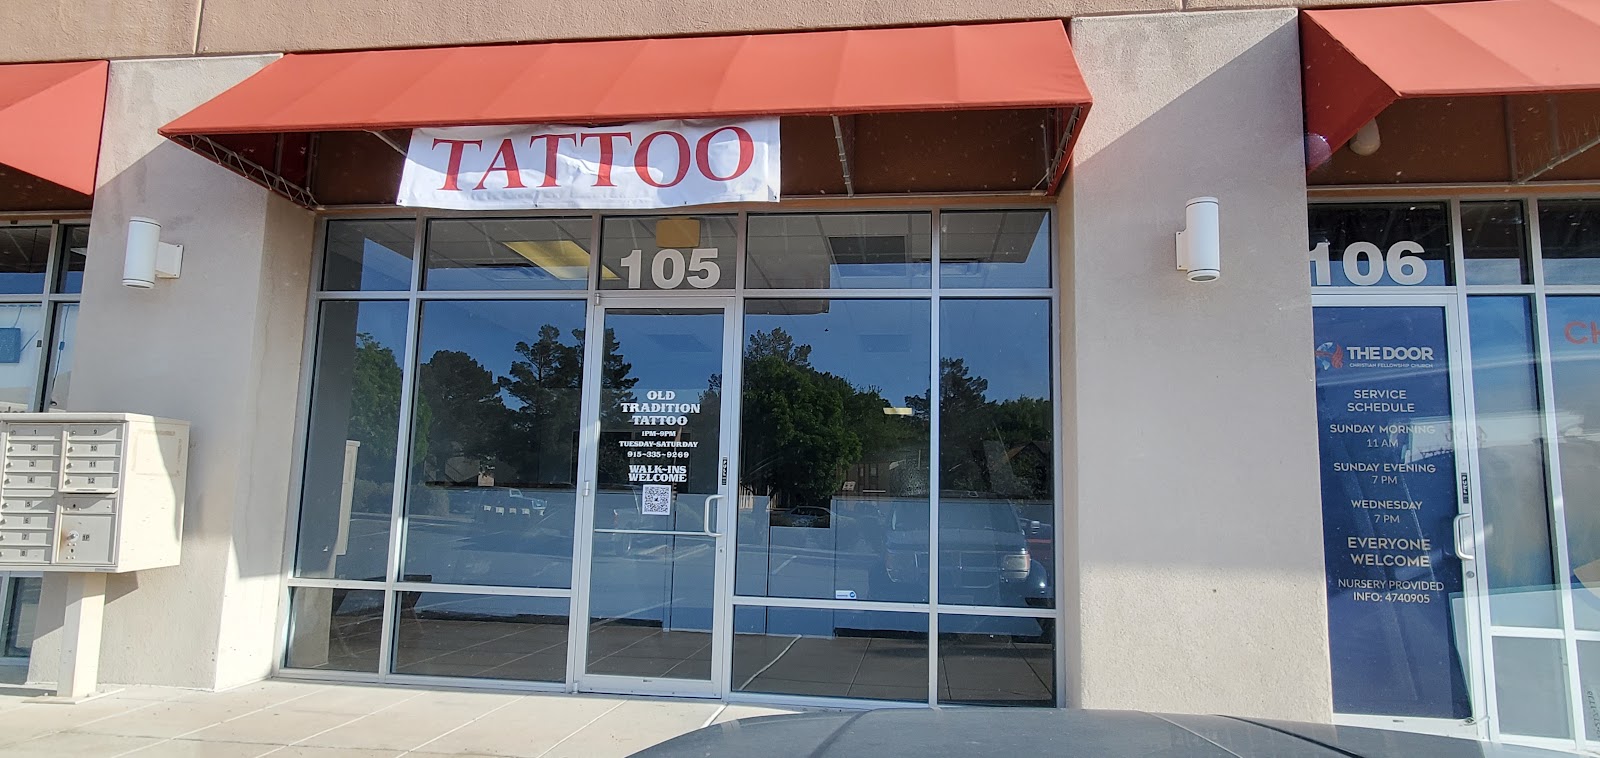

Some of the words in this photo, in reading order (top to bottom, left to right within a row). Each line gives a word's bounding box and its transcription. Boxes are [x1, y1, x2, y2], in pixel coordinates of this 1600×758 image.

[432, 126, 754, 191] TATTOO
[620, 248, 721, 289] 105
[1309, 241, 1427, 286] 106
[1346, 347, 1380, 360] THE
[1383, 347, 1434, 360] DOOR
[646, 390, 676, 400] OLD
[1354, 390, 1407, 400] SERVICE
[620, 402, 700, 413] TRADITION
[1347, 402, 1415, 412] SCHEDULE
[632, 416, 688, 426] TATTOO
[1330, 424, 1375, 433] SUNDAY
[1379, 426, 1436, 434] MORNING
[1367, 438, 1379, 448] 11
[1381, 438, 1398, 448] AM
[1334, 463, 1379, 472] SUNDAY
[1384, 464, 1436, 472] EVENING
[628, 474, 687, 482] WELCOME
[1350, 500, 1422, 510] WEDNESDAY
[1384, 515, 1400, 523] PM
[1348, 537, 1431, 550] EVERYONE
[1350, 554, 1430, 567] WELCOME
[1338, 579, 1386, 588] NURSERY
[1389, 581, 1444, 590] PROVIDED
[1353, 592, 1383, 602] INFO:
[1385, 594, 1430, 604] 4740905
